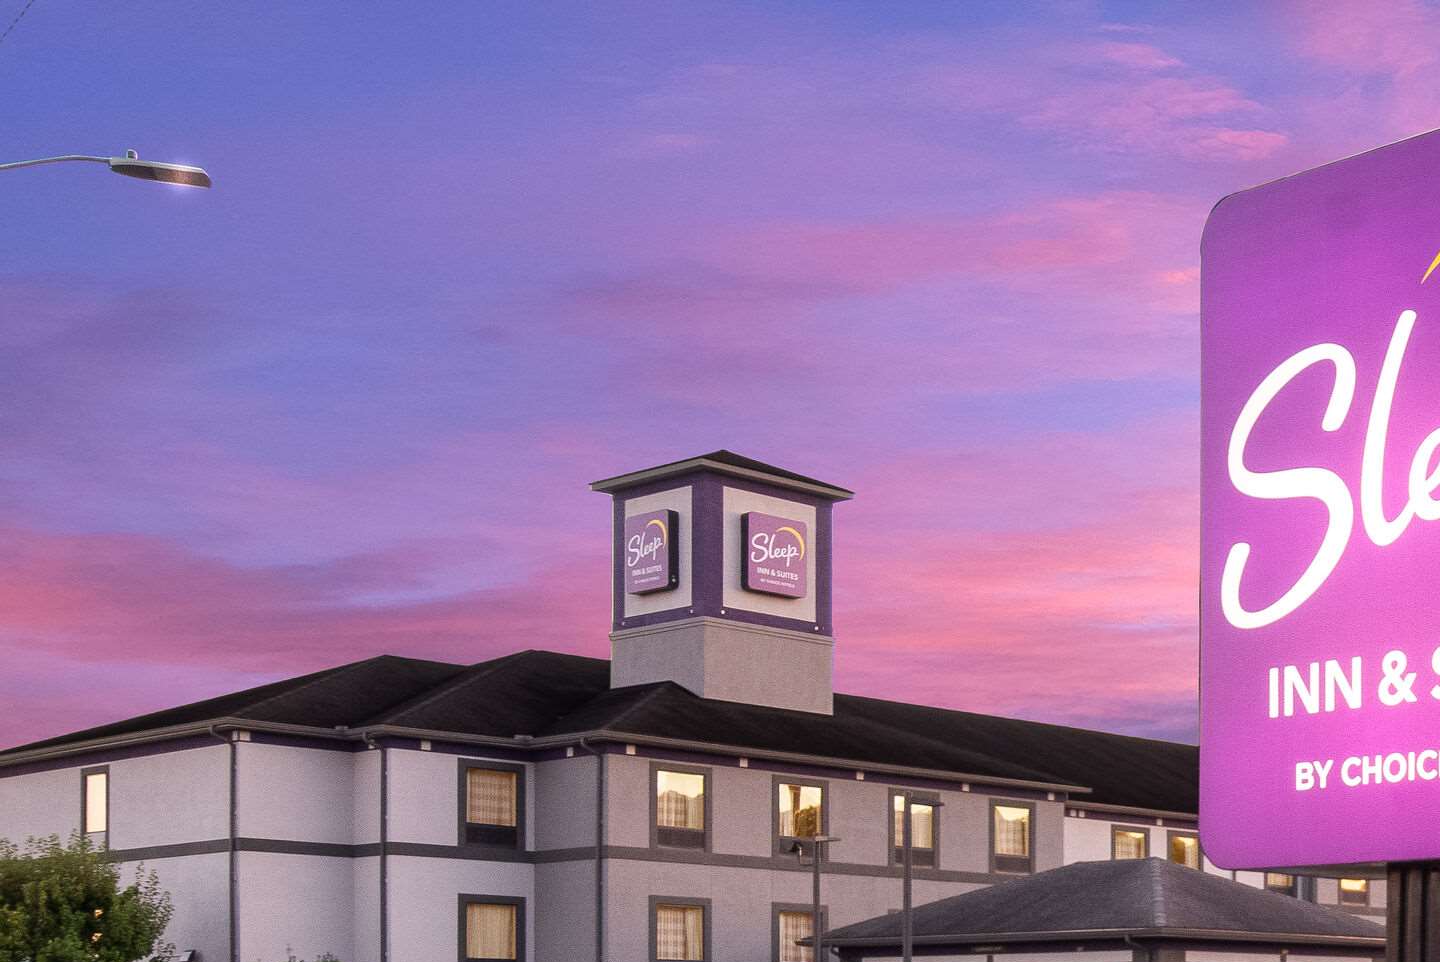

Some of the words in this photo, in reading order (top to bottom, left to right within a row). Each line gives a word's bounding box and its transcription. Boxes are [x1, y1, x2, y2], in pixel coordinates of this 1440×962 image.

[627, 531, 664, 567] Sleep
[751, 532, 799, 567] Sleep
[756, 566, 770, 576] INN
[776, 569, 799, 581] SUITES
[1268, 656, 1362, 718] INN
[1377, 650, 1417, 706] &
[1295, 760, 1333, 791] BY
